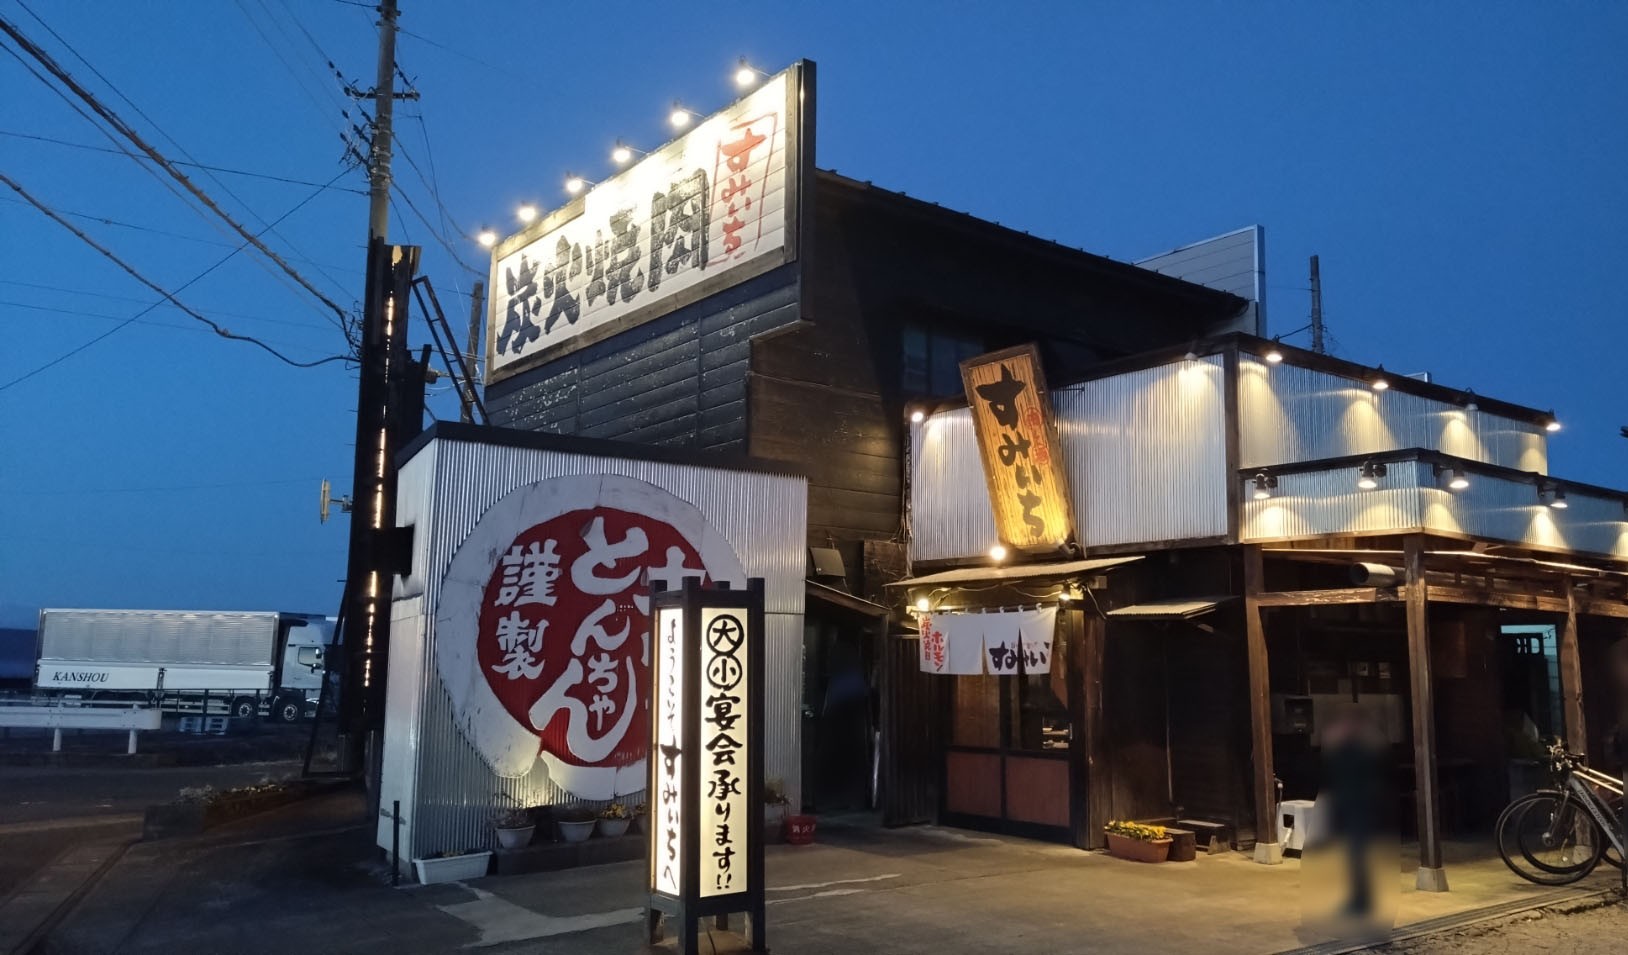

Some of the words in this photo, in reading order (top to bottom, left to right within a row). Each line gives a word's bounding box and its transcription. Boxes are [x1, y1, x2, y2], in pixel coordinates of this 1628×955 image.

[721, 128, 767, 255] すみいち
[975, 363, 1046, 538] すみいち
[492, 538, 562, 681] 謹製
[932, 631, 945, 673] ホルモン
[52, 671, 109, 683] KANSHOU
